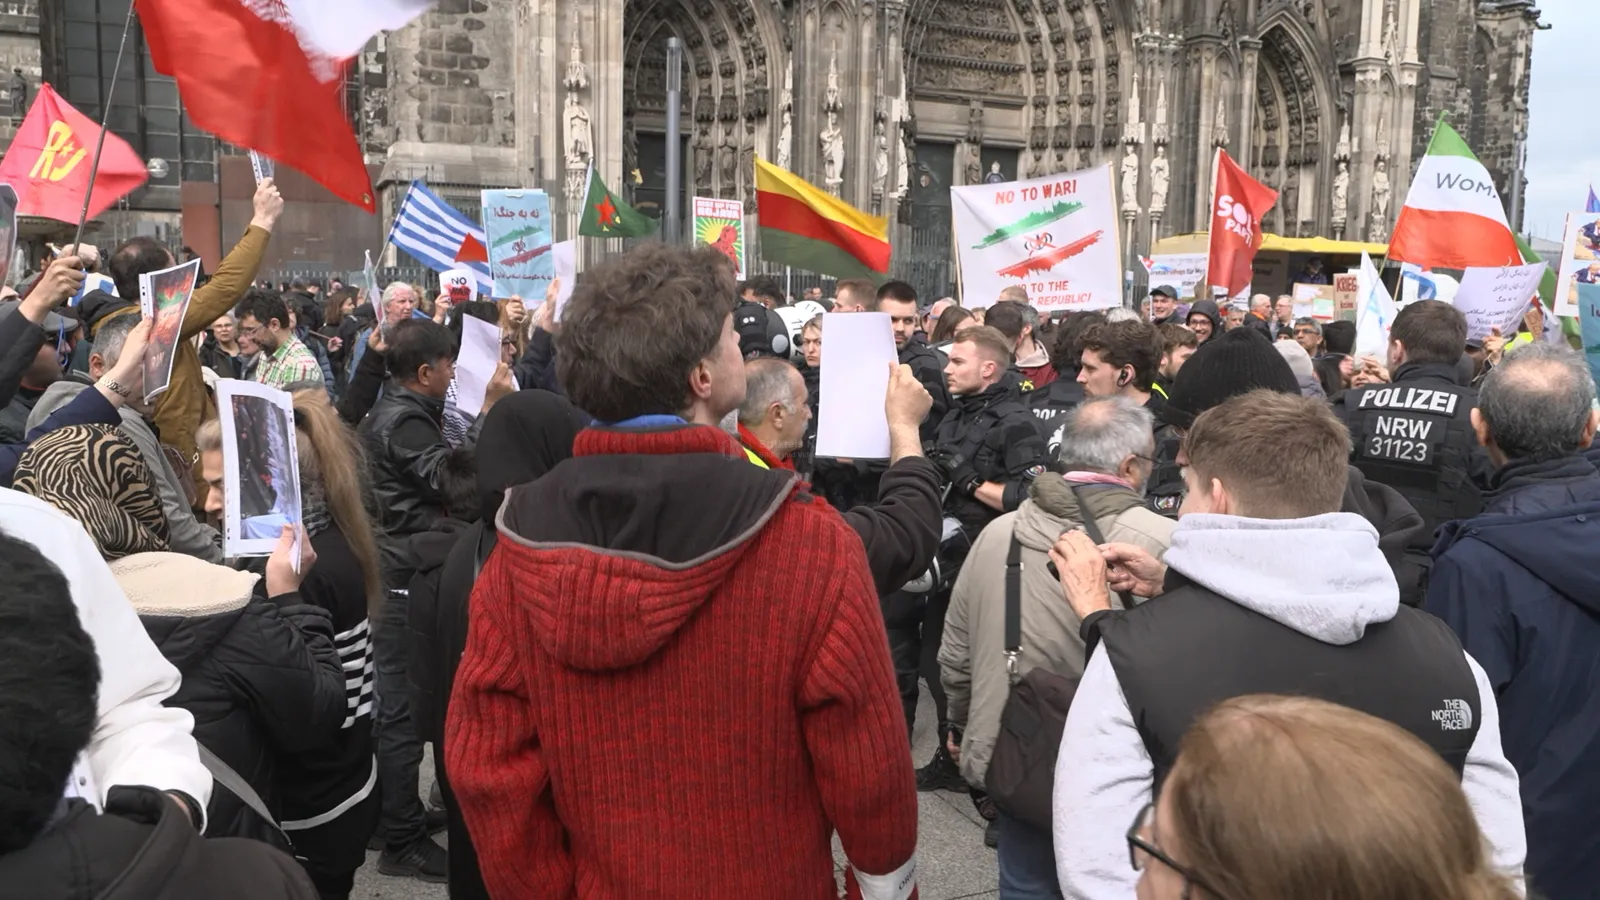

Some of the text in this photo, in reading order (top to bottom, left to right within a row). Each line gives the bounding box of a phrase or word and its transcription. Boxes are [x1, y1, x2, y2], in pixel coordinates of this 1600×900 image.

[996, 190, 1014, 204] NO
[1021, 187, 1038, 201] TO
[451, 277, 467, 285] NO
[1031, 282, 1044, 293] TO
[1048, 280, 1069, 292] THE
[1336, 277, 1357, 292] KRIEG
[1359, 387, 1458, 414] POLIZEI
[1375, 416, 1432, 440] NRW
[1370, 436, 1427, 462] 31123
[1443, 699, 1461, 709] THE
[1431, 709, 1462, 721] NORTH
[1441, 719, 1463, 730] FACE
